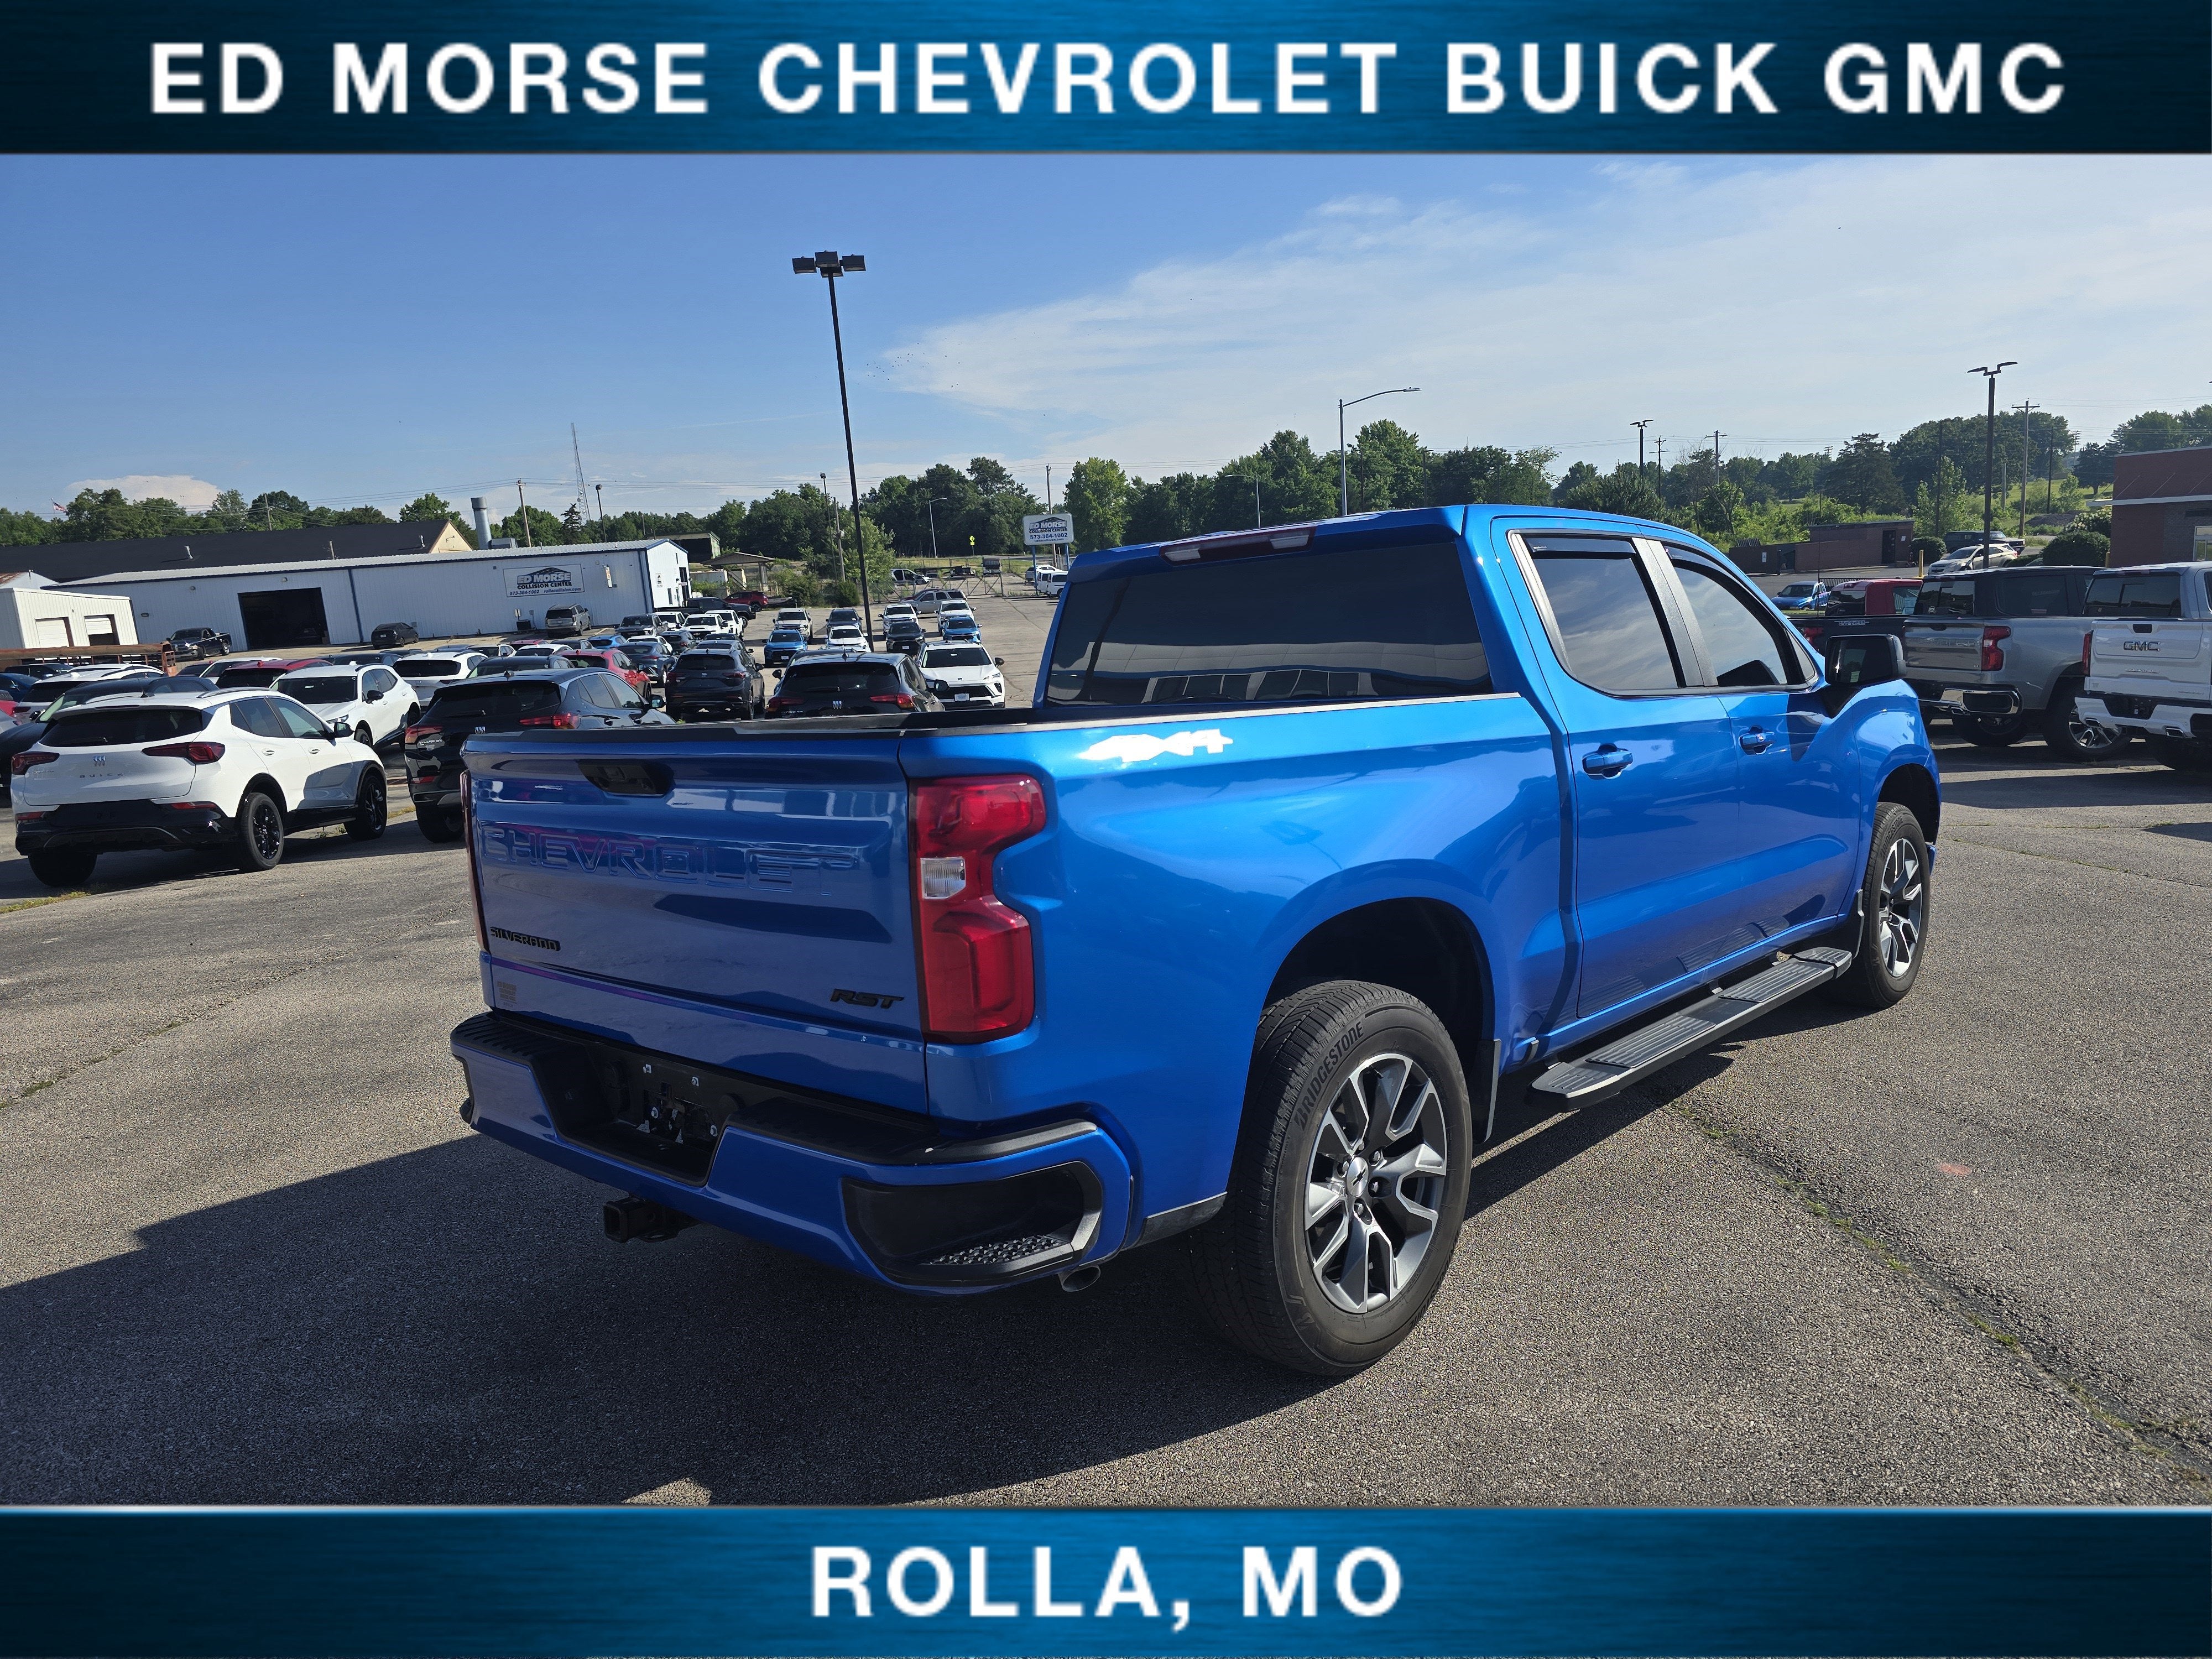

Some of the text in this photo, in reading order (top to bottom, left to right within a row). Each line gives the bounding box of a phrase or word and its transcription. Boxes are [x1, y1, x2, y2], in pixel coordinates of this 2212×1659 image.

[533, 572, 571, 583] MORSE
[2124, 641, 2161, 651] GMC
[483, 828, 859, 896] CHEVROLET
[490, 926, 561, 952] SILVERADO
[830, 988, 905, 1009] RST
[1294, 1021, 1364, 1131] BRIDGESTONE
